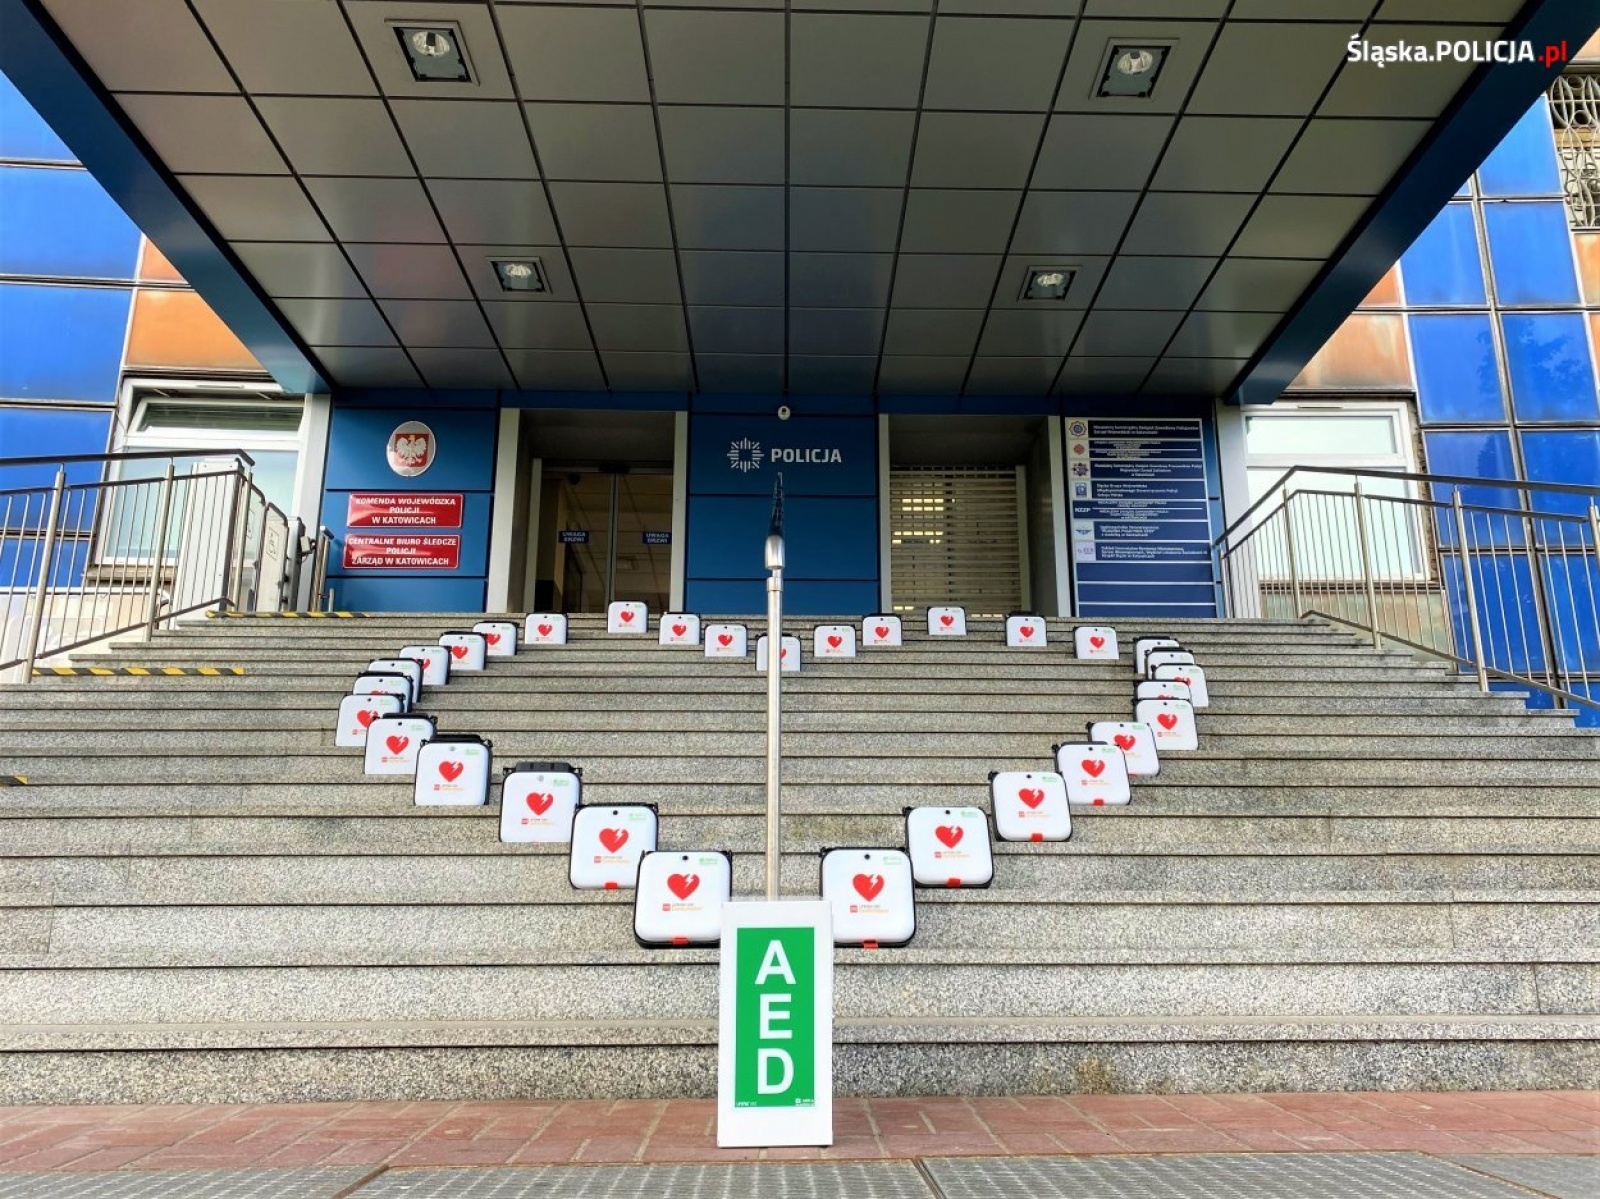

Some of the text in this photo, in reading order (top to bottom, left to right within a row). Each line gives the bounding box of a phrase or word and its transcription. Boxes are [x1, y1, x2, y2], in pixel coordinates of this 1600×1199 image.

[771, 448, 842, 463] POLICJA
[355, 496, 456, 505] KOMENDA WOJEWÓDZKA
[372, 516, 436, 524] W KATOWICACH
[422, 536, 457, 546] ŚLEDCZE
[386, 547, 417, 555] POLICJI
[352, 557, 449, 567] ZARZĄD W KATOWICACH
[754, 939, 797, 1095] AED
